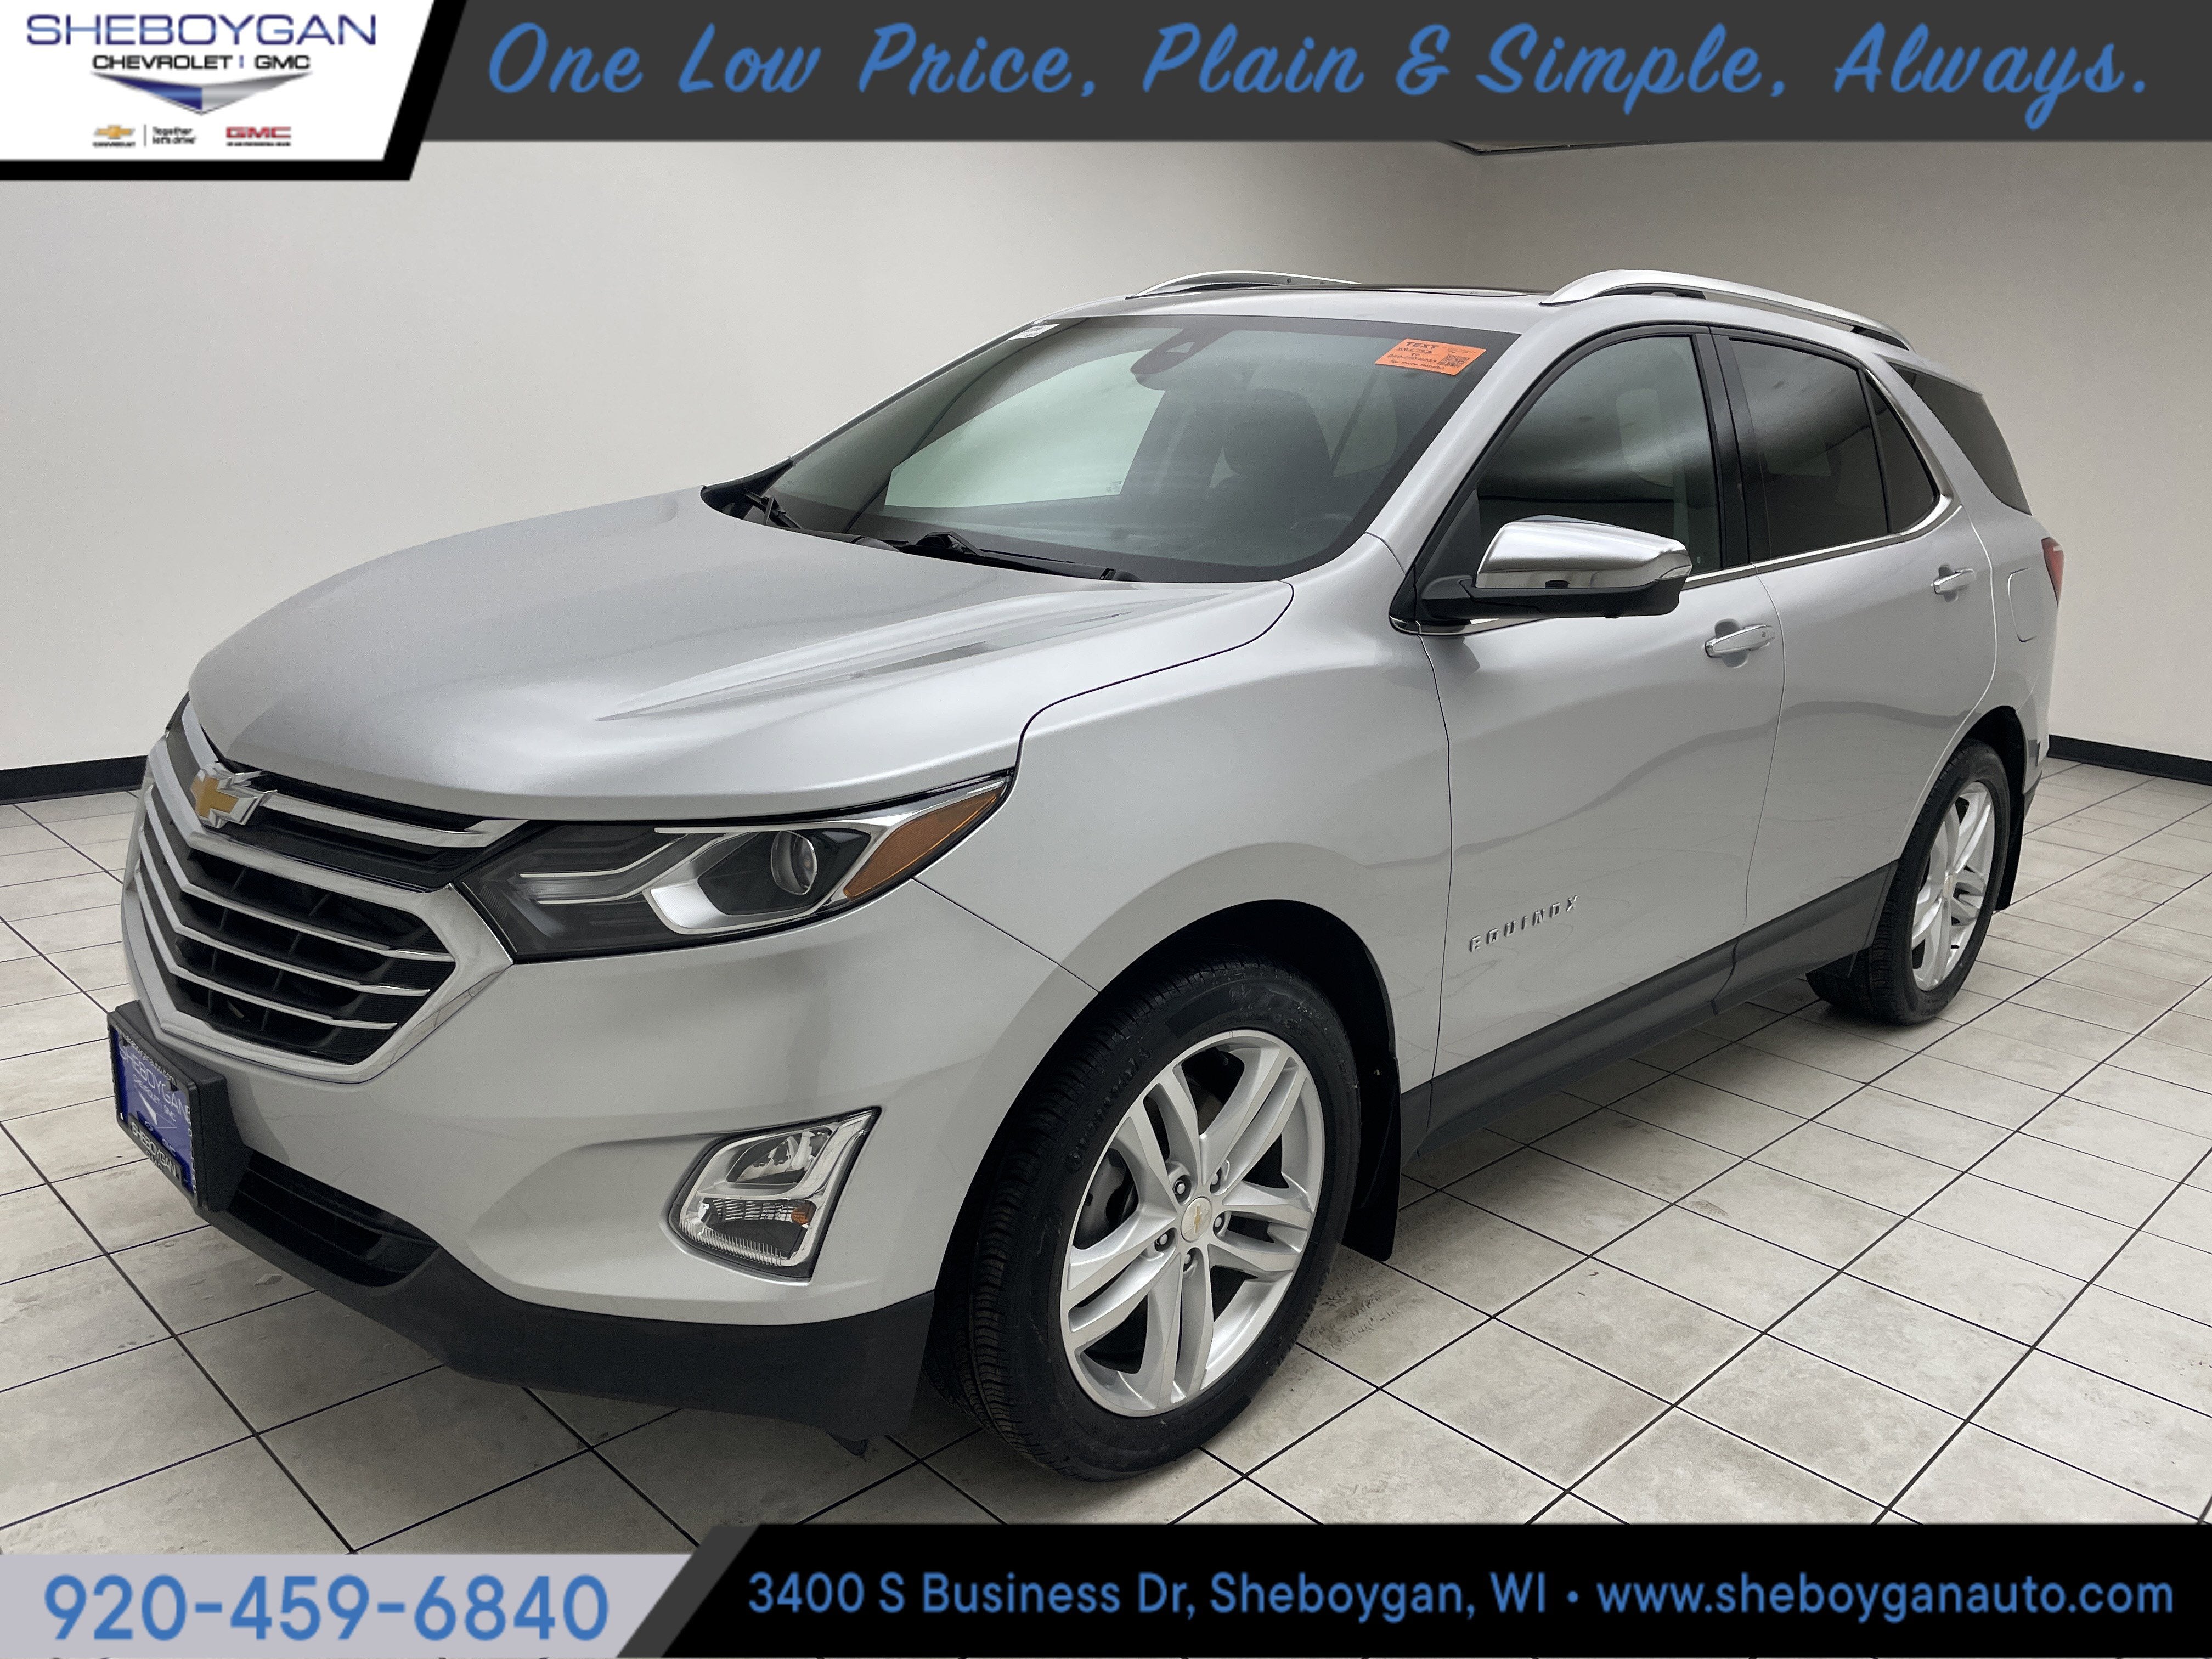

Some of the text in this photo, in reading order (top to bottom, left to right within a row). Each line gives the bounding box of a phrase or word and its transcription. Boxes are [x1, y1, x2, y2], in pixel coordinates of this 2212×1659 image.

[1469, 894, 1578, 952] EQUINOX
[119, 1044, 189, 1124] SHEBOYGAN
[131, 1121, 177, 1178] SHEBOYGAN
